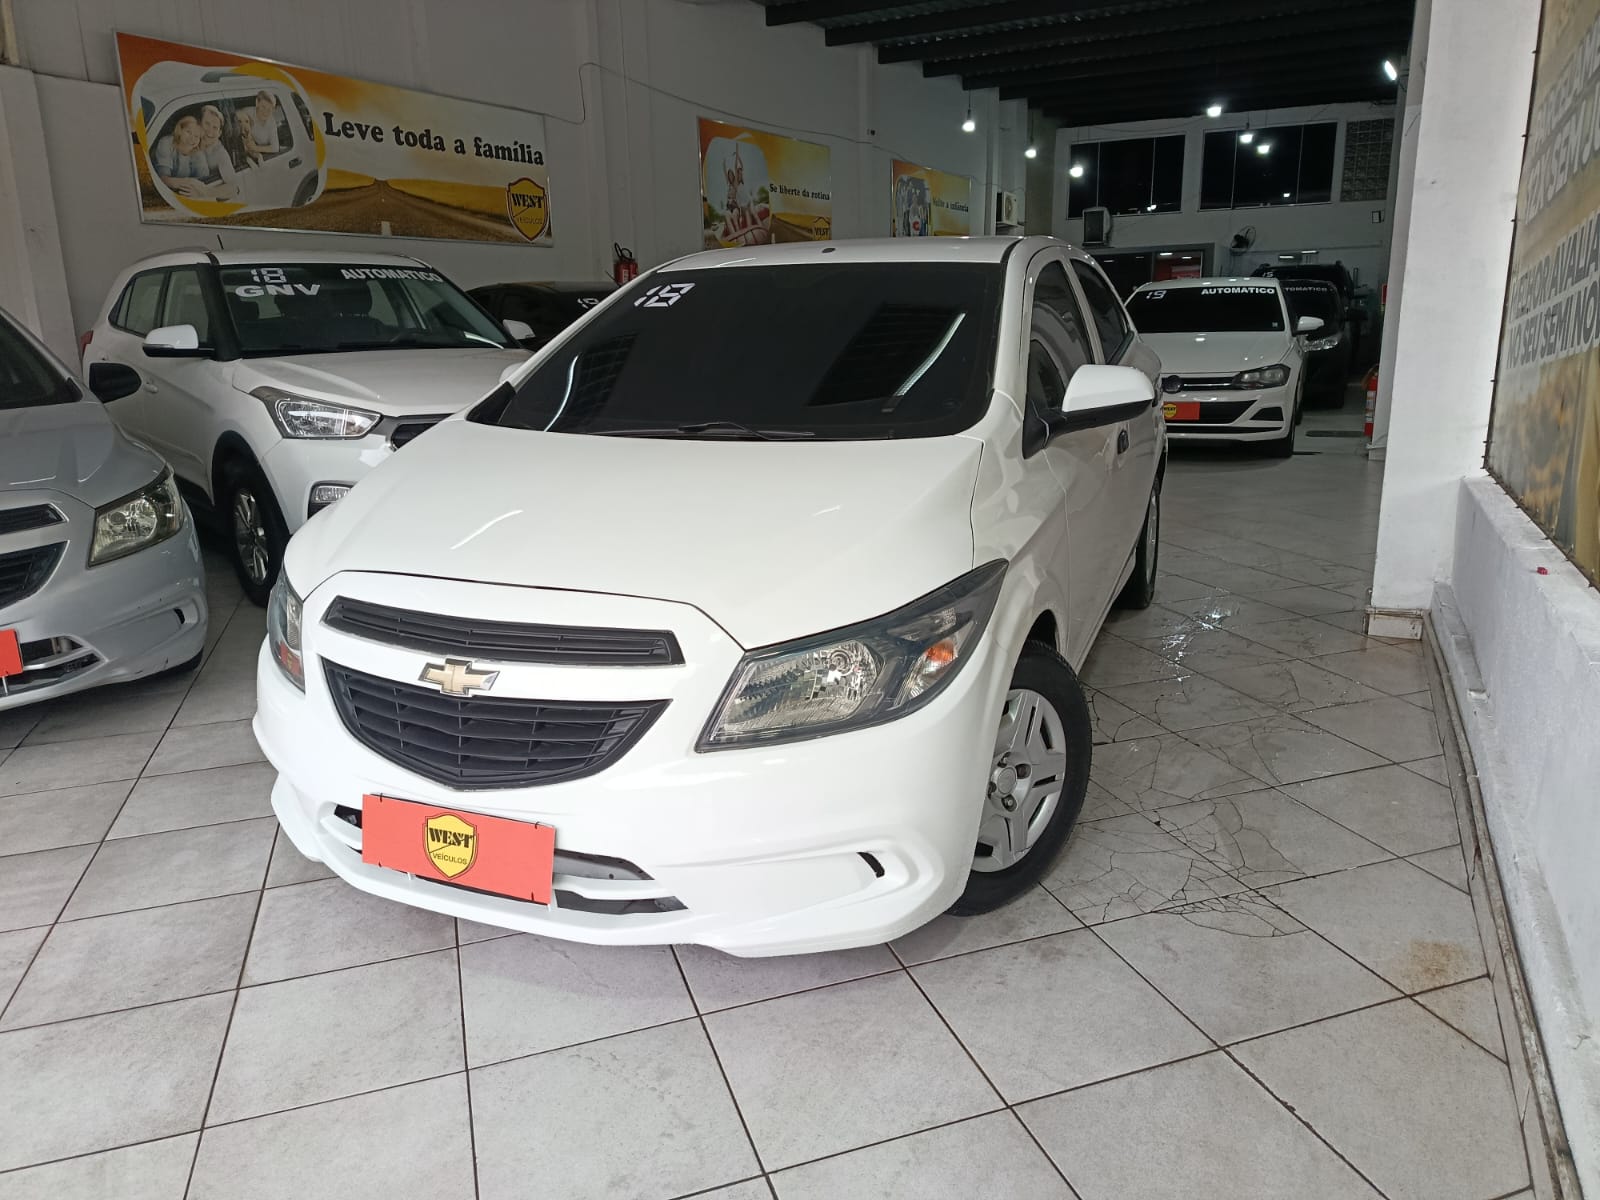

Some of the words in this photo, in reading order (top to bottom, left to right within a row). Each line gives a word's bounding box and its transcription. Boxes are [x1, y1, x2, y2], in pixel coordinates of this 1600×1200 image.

[323, 112, 384, 143] Leve
[393, 125, 446, 152] toda
[454, 137, 466, 155] a
[474, 136, 545, 166] família
[1547, 99, 1586, 201] SEM
[511, 193, 545, 208] WEST
[341, 269, 443, 283] AUTOMATICO
[235, 284, 320, 297] GNV
[1201, 286, 1275, 295] AUTOMATICO
[1521, 312, 1543, 366] SEU
[429, 827, 473, 848] WEST
[433, 852, 468, 865] VEÍCULOS
